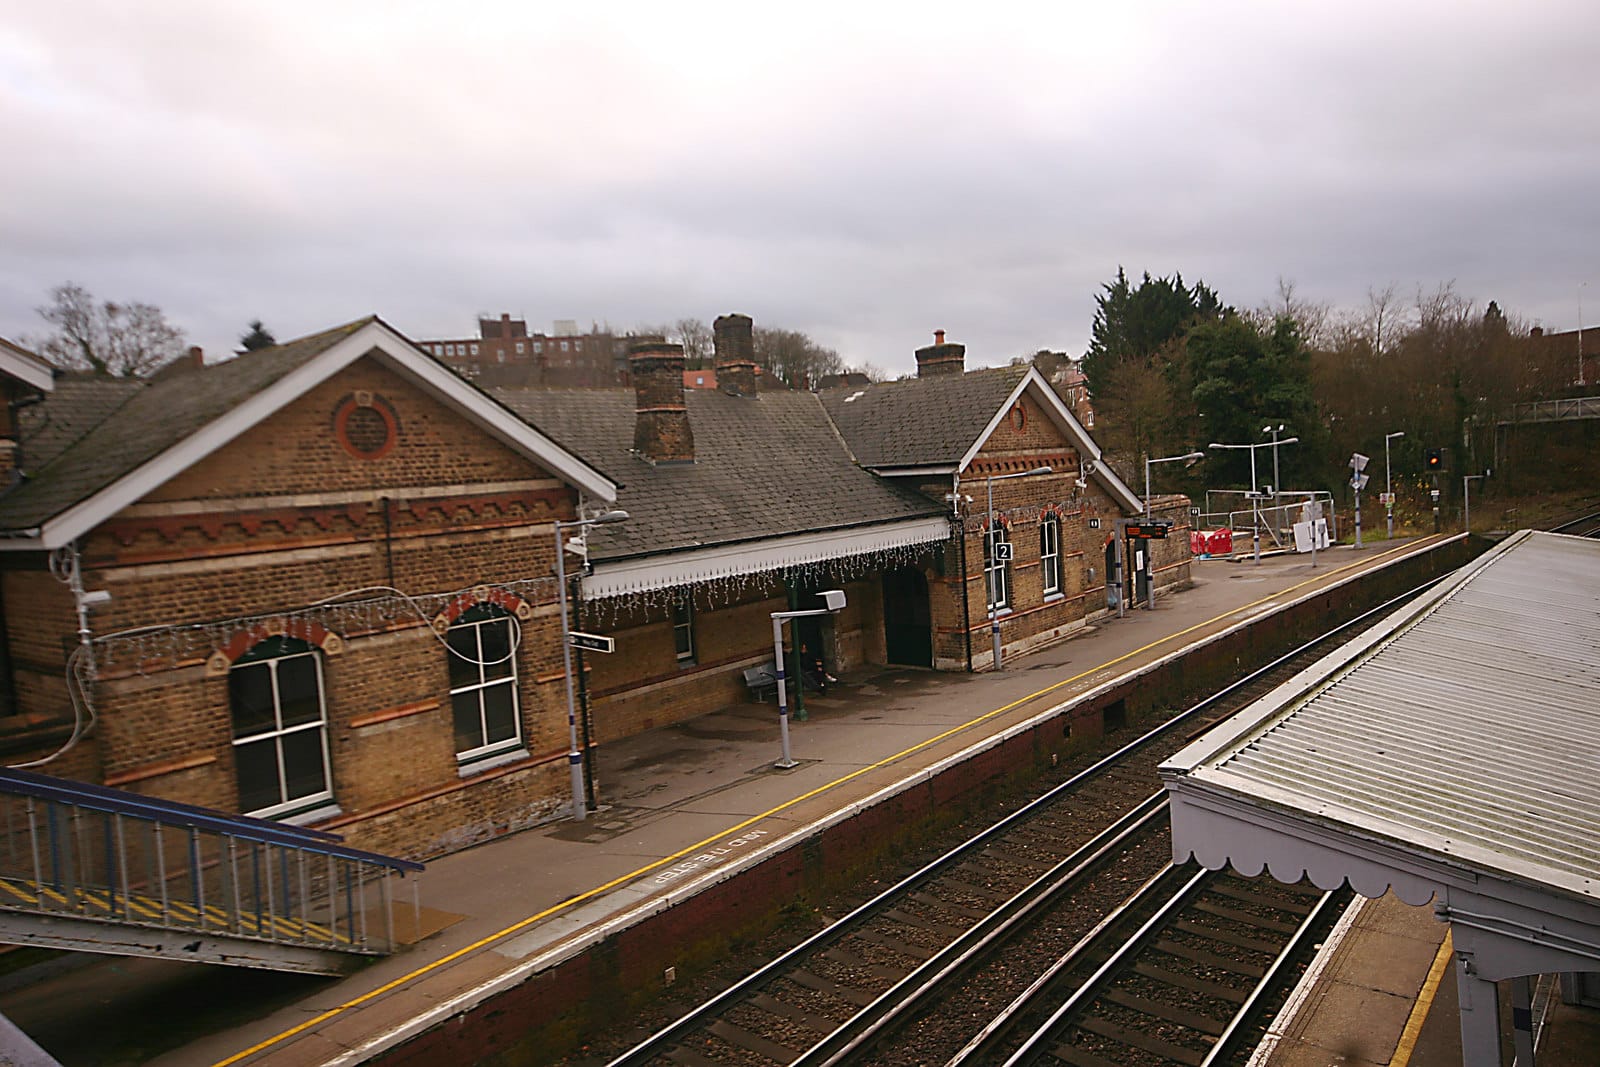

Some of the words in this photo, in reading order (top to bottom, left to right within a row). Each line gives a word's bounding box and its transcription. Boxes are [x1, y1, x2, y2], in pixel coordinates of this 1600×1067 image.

[1000, 545, 1008, 558] 2
[728, 829, 768, 847] MIND
[694, 847, 733, 863] THE
[654, 861, 699, 884] STEP
